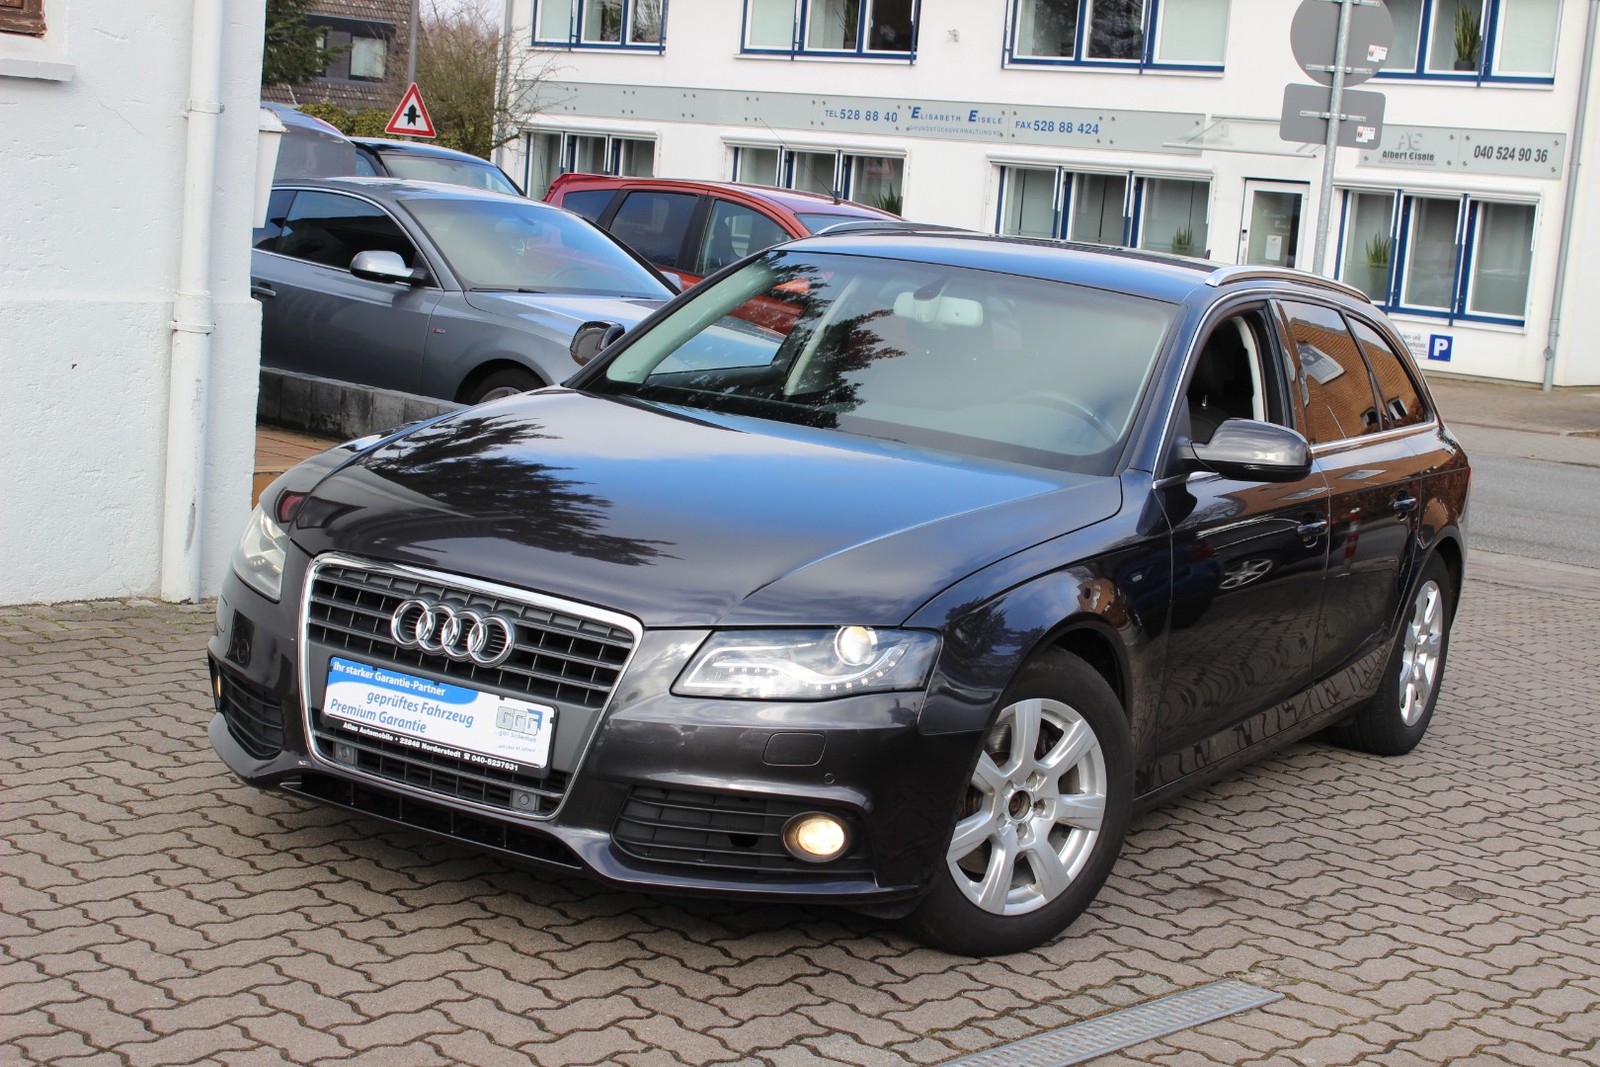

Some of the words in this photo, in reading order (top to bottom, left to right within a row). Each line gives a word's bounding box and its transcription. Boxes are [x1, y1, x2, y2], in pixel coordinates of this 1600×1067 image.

[825, 109, 838, 118] TEL
[840, 109, 860, 120] 528
[865, 110, 879, 121] 88
[884, 112, 898, 122] 40
[1015, 121, 1031, 129] FAX
[1033, 120, 1055, 132] 528
[1058, 122, 1073, 133] 88
[1077, 123, 1099, 134] 424
[1382, 150, 1408, 159] Albert
[1409, 152, 1435, 161] Eisele
[1474, 145, 1494, 159] 040
[1496, 146, 1516, 160] 524
[1518, 147, 1532, 161] 90
[1534, 148, 1549, 163] 36
[1433, 338, 1449, 357] P
[333, 661, 345, 672] Ihr
[346, 665, 374, 679] starker
[375, 672, 446, 696] Garantie-Partner
[330, 698, 377, 721] Premium
[378, 711, 427, 734] Garantie
[366, 692, 419, 713] geprüftes
[420, 702, 475, 728] Fahrzeug
[359, 726, 393, 741] Automobile
[421, 743, 461, 758] Norderstedt
[471, 755, 519, 771] 040-5237631
